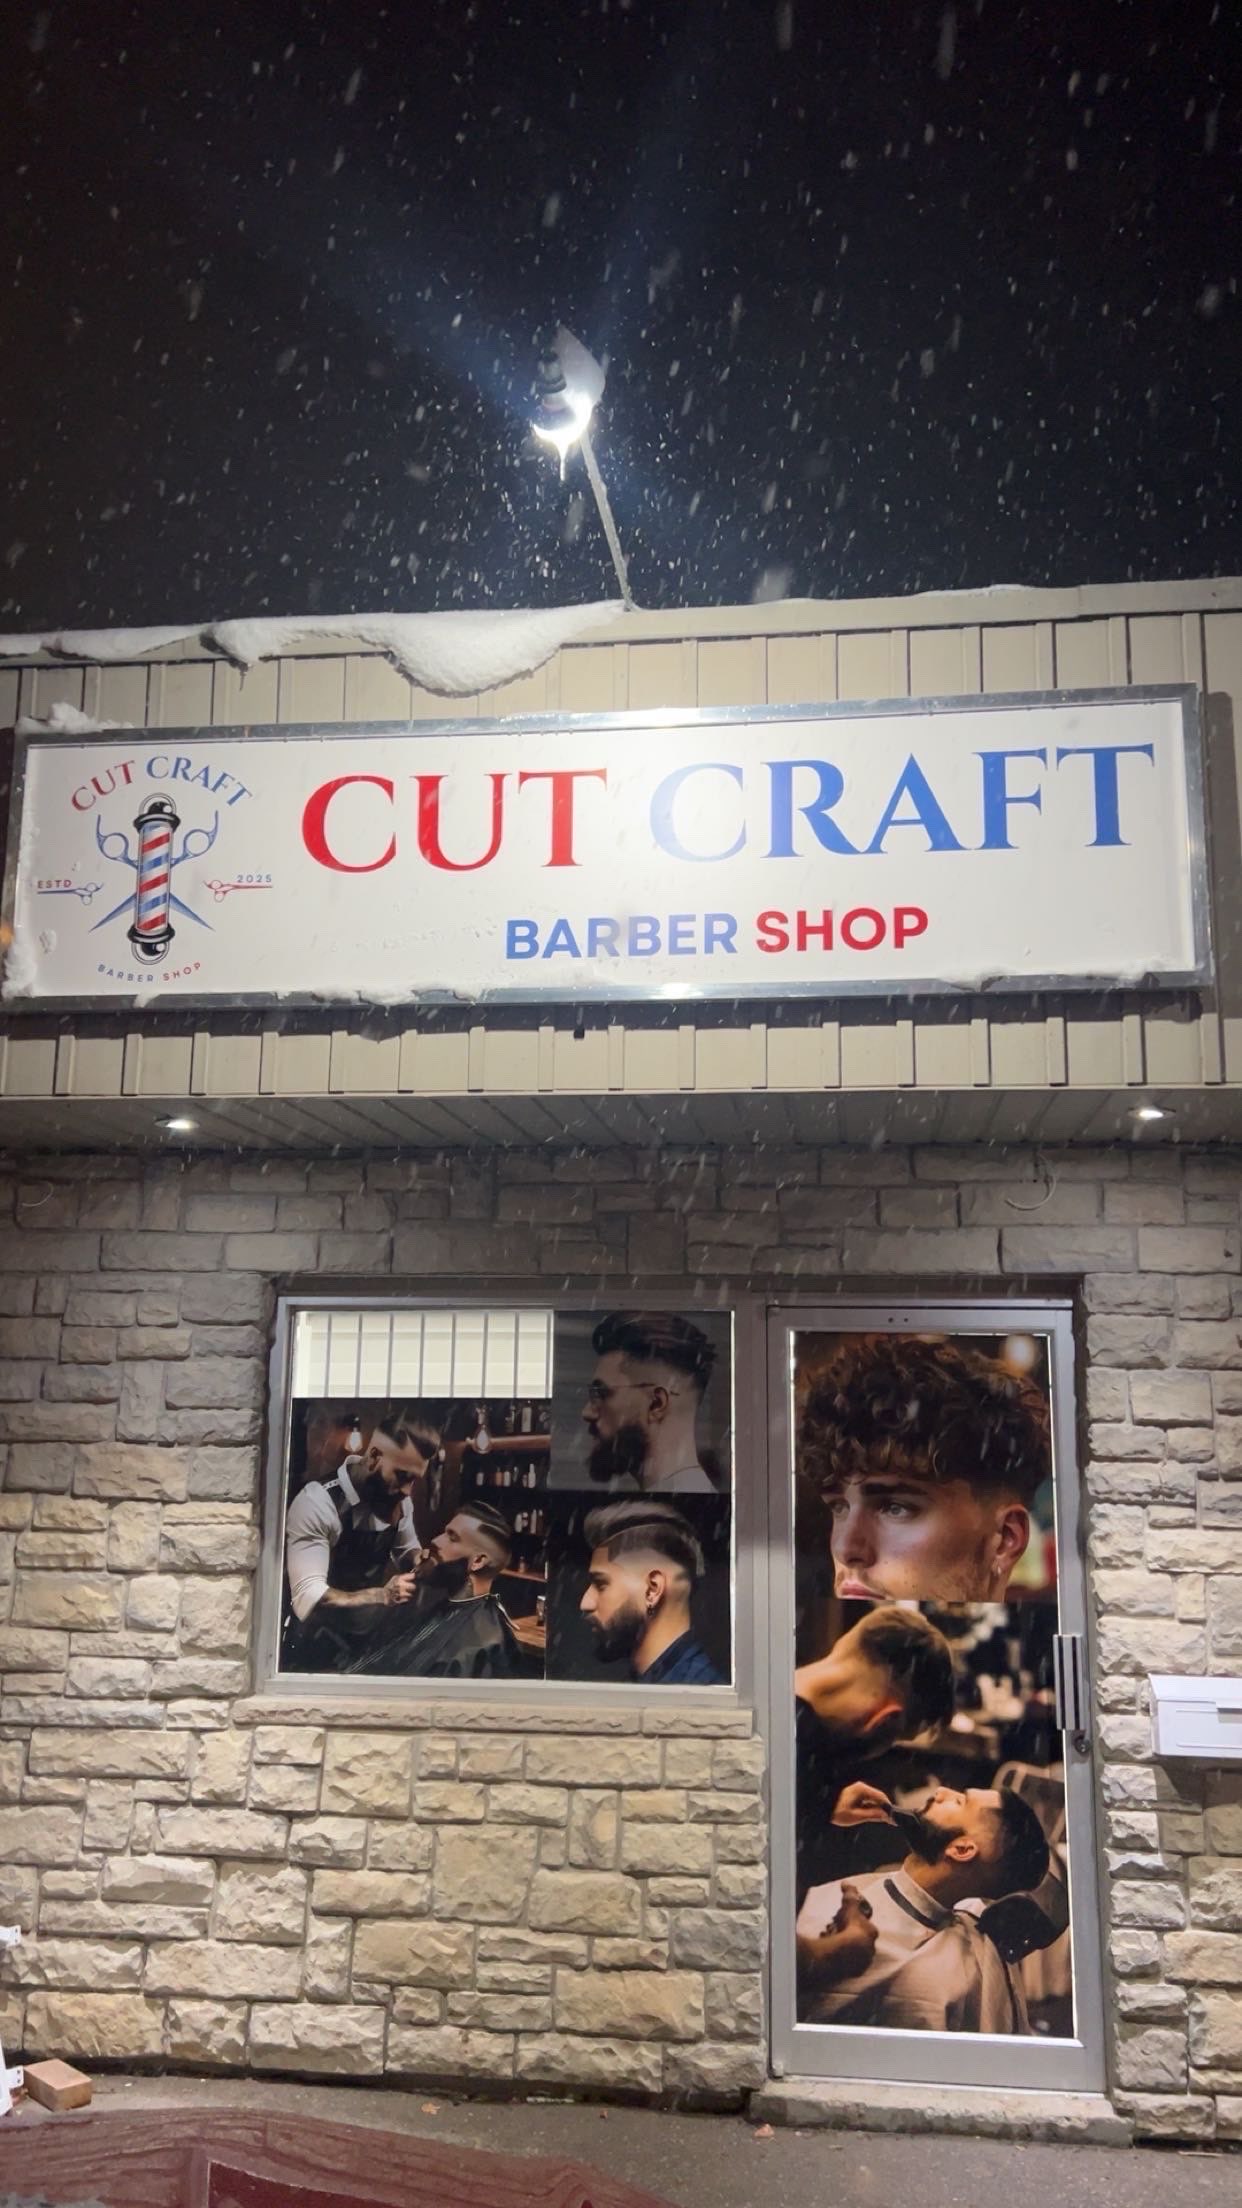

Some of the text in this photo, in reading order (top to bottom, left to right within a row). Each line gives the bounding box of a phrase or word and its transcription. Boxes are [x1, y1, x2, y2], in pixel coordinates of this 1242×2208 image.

[71, 756, 253, 811] CUT CRAFT
[301, 743, 1154, 873] CUT CRAFT
[37, 879, 72, 889] ESTD
[236, 874, 272, 883] 2025
[505, 906, 929, 960] BARBER SHOP
[97, 962, 201, 982] BARBER SHOP
